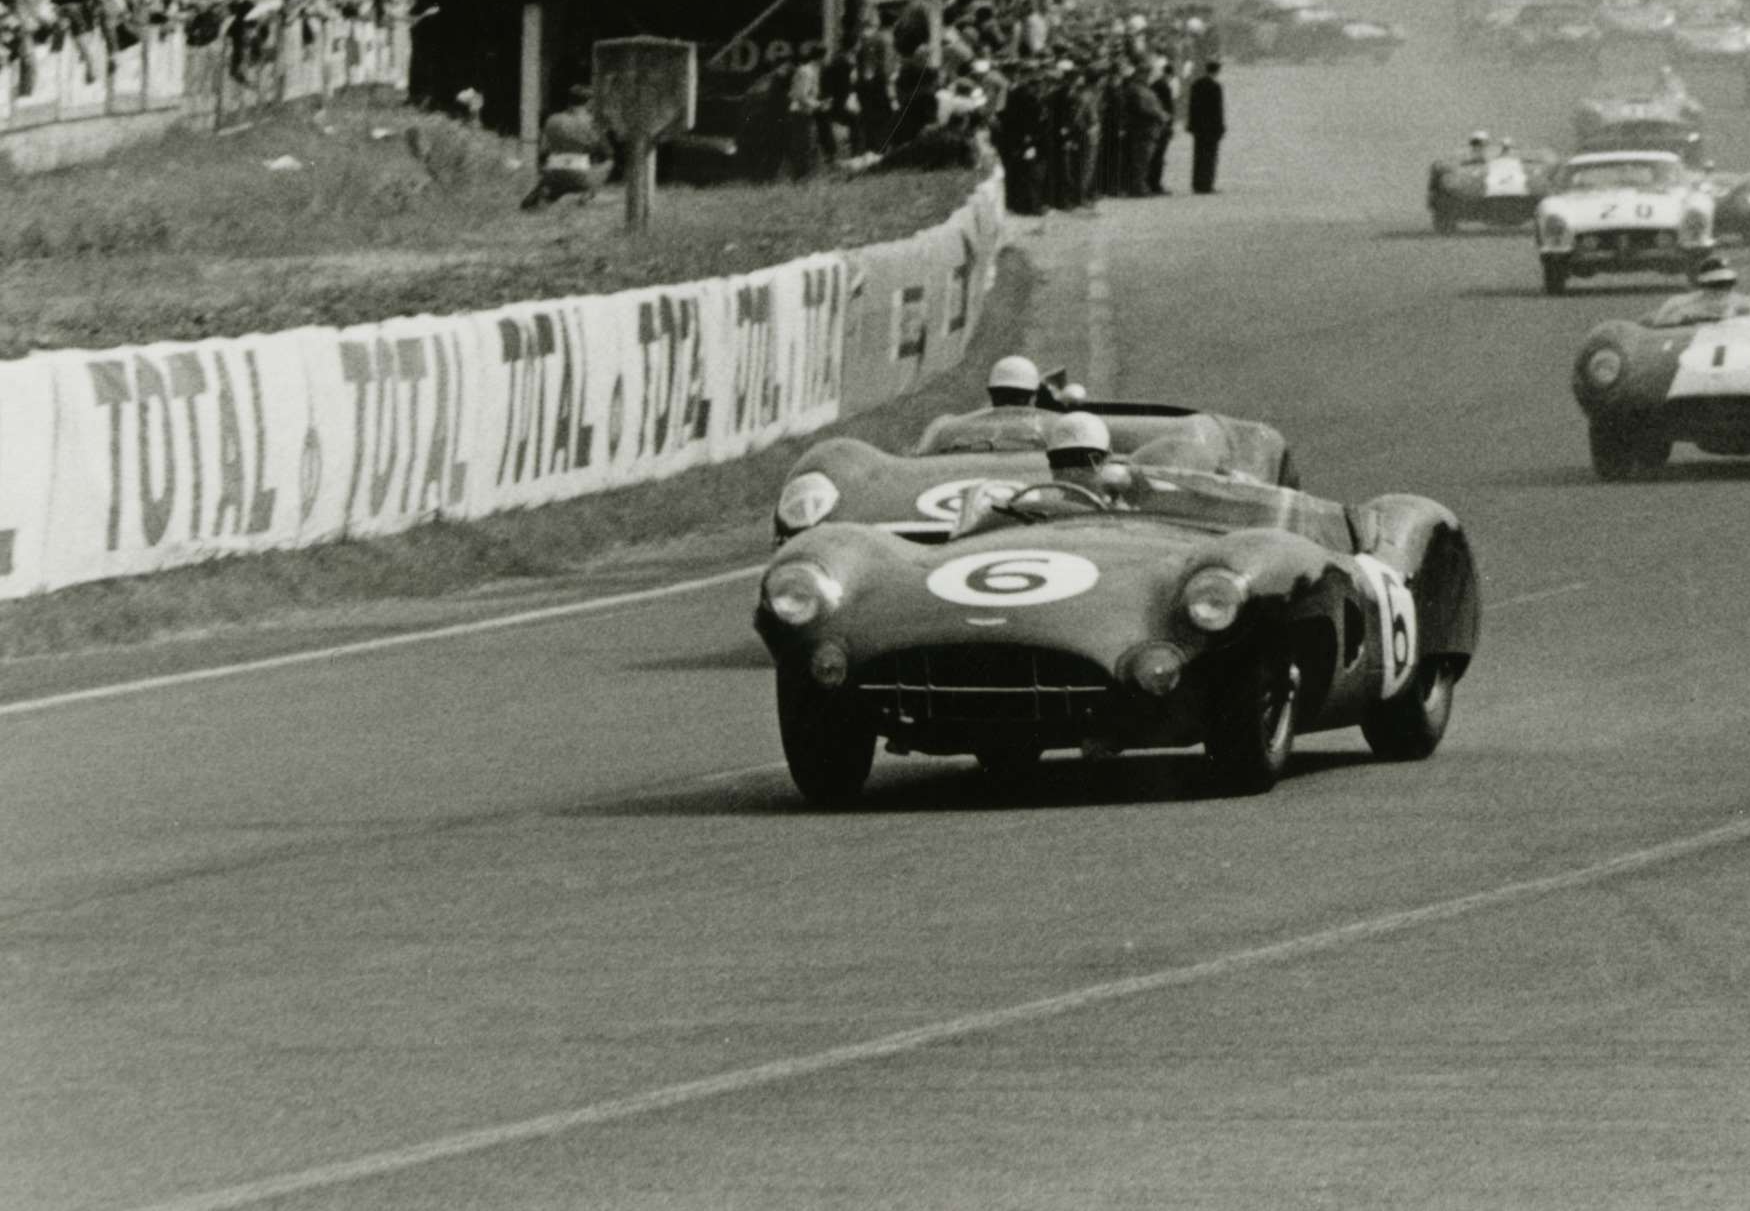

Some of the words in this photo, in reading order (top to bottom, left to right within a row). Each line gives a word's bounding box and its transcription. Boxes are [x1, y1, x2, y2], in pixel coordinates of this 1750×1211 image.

[339, 333, 467, 524] TOTAL
[497, 307, 593, 486] TOTAL
[1712, 345, 1727, 367] 1
[88, 350, 277, 551] TOTAL
[965, 559, 1051, 594] 6
